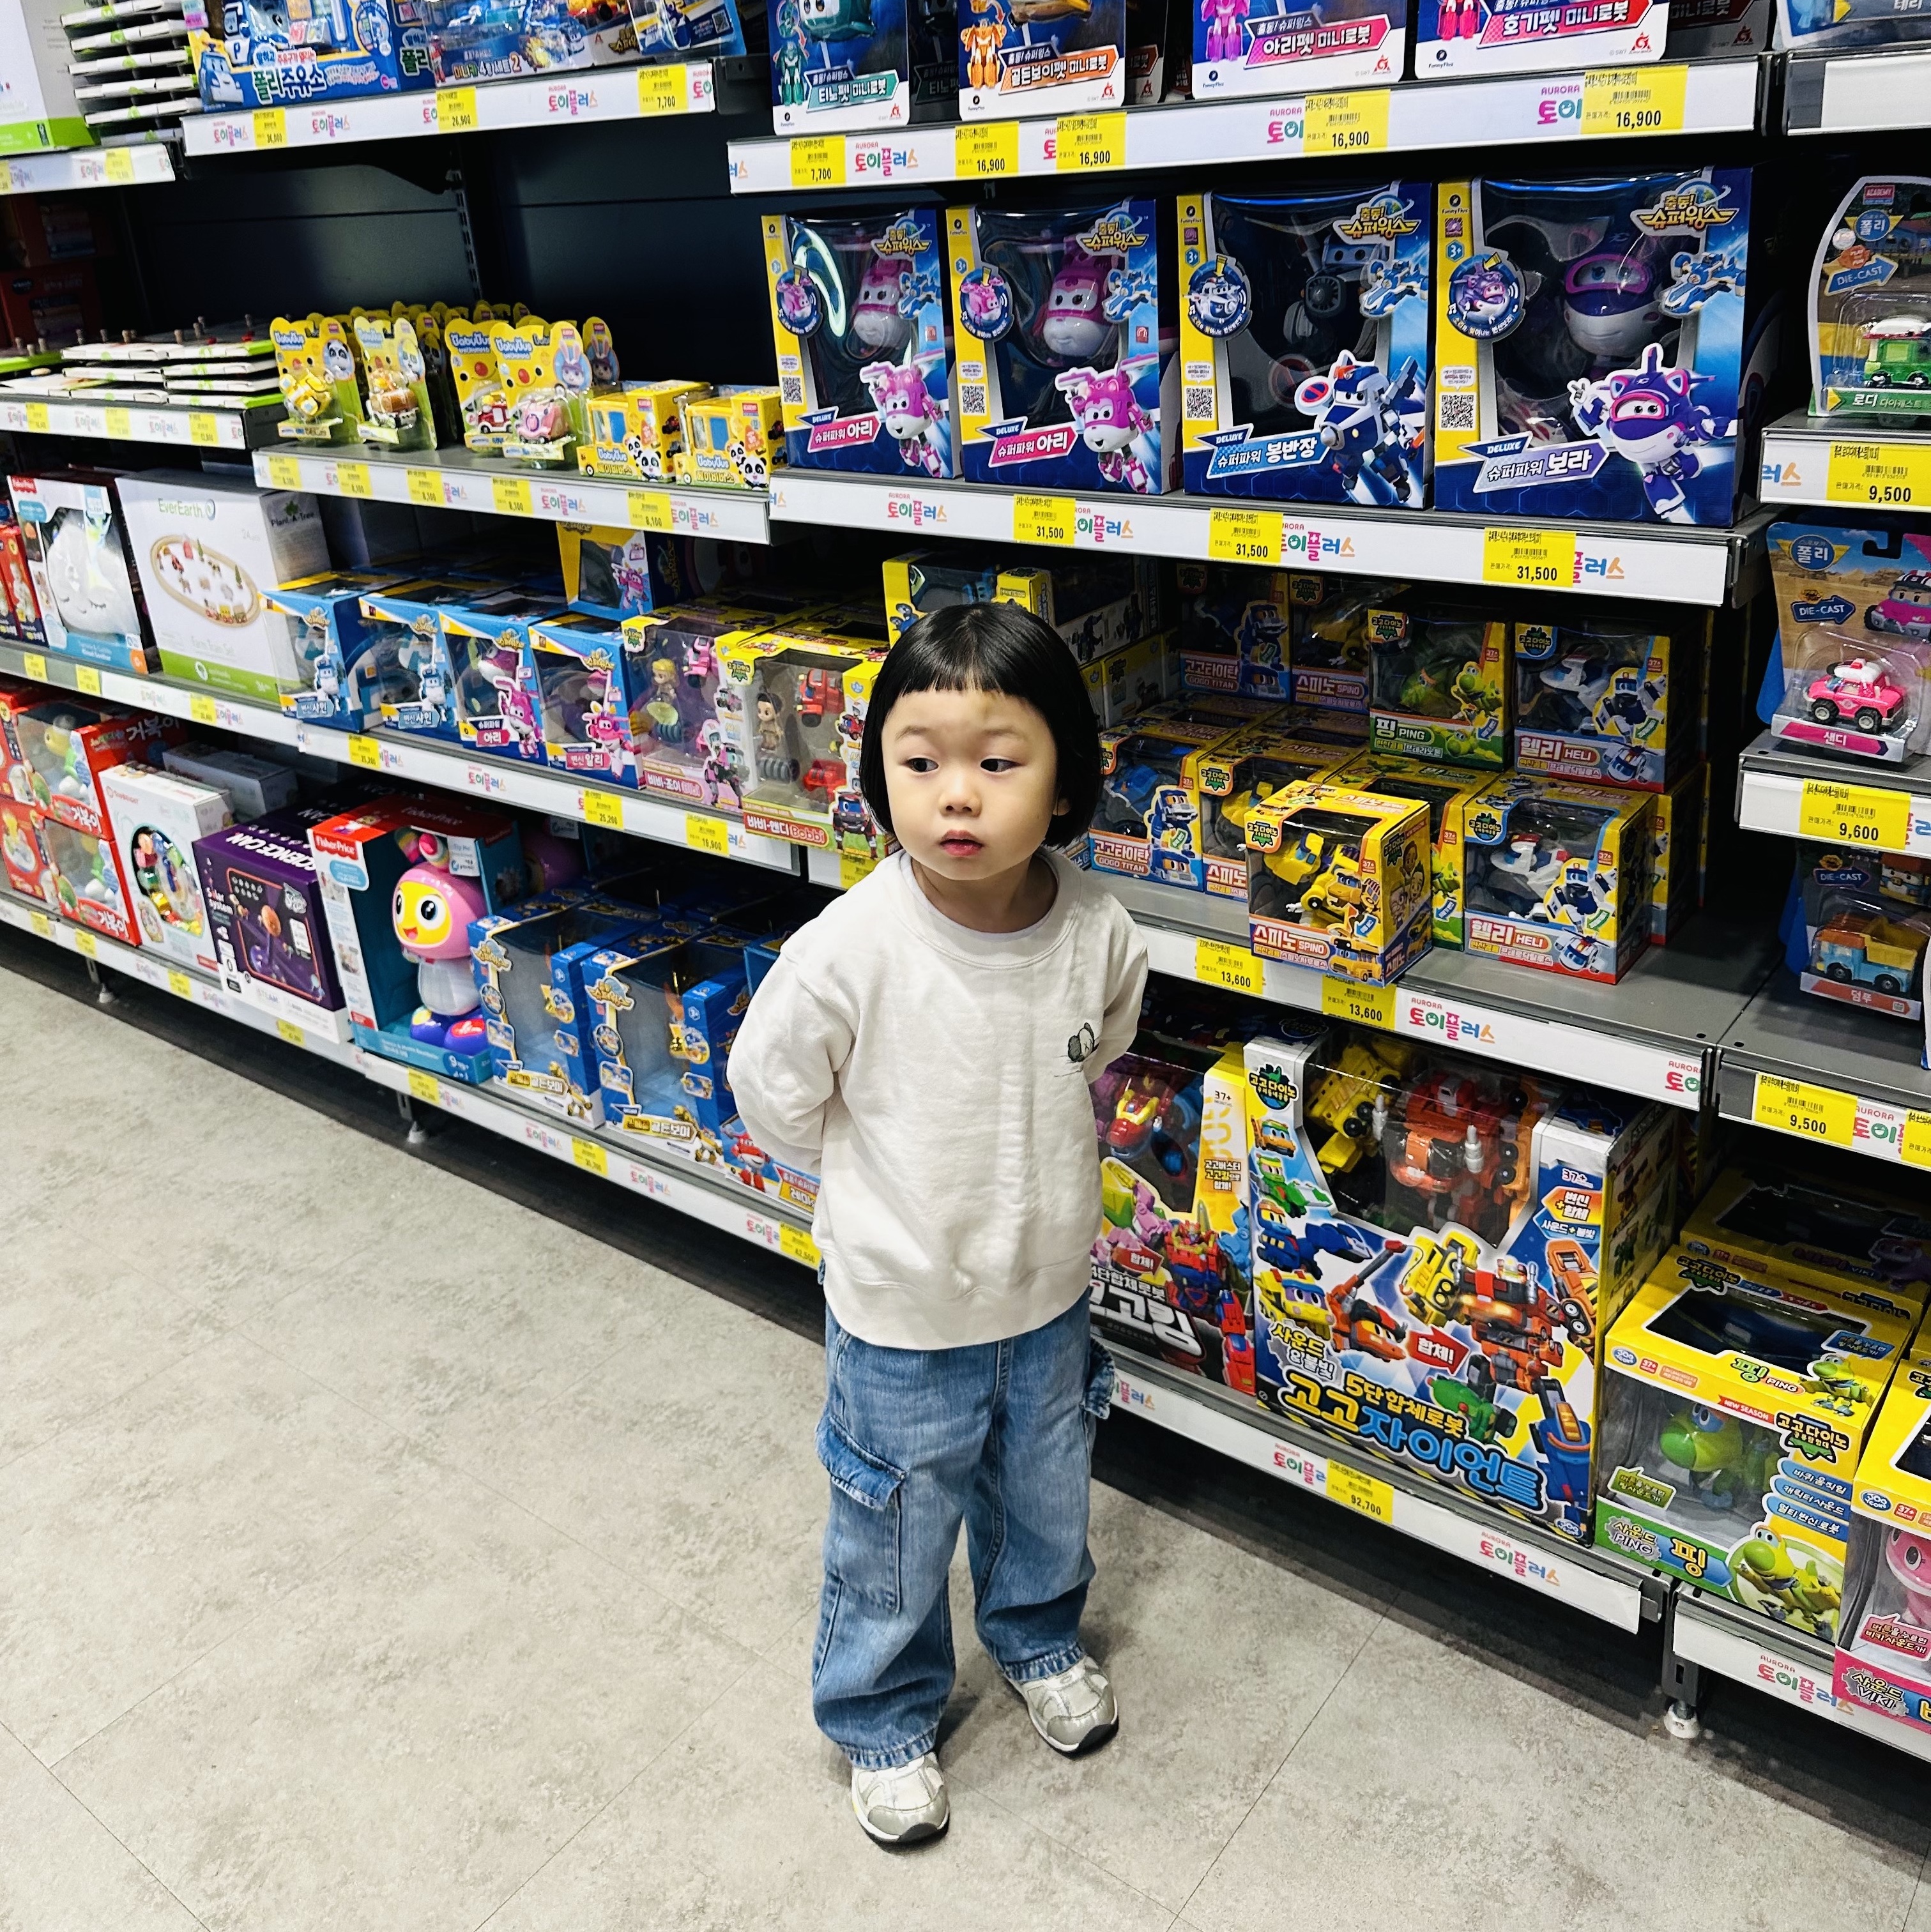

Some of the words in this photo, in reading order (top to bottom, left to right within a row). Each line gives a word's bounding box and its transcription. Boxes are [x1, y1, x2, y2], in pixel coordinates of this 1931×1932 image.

[1502, 13, 1563, 36] 호기펫
[1565, 1, 1630, 26] 미니로봇
[1263, 31, 1316, 58] 아리펫
[1317, 24, 1371, 49] 미니로봇
[510, 54, 521, 73] 2
[1541, 84, 1580, 95] AURORA
[1270, 107, 1302, 116] AURORA
[1615, 110, 1661, 128] 16,900
[1331, 131, 1370, 148] 16,900
[855, 149, 919, 176] 토이플러스
[976, 158, 1005, 172] 16,900
[1080, 150, 1110, 165] 16,900
[811, 168, 832, 181] 7,700
[1640, 206, 1736, 231] 슈퍼윙스
[1860, 219, 1886, 236] 폴리
[1450, 245, 1462, 257] 3+
[1836, 266, 1883, 286] DIE-CAST
[1852, 393, 1877, 407] 로디
[847, 416, 874, 438] 아리
[1037, 430, 1069, 452] 아리
[1216, 432, 1243, 444] DELUXE
[1487, 442, 1522, 454] DELUXE
[1217, 450, 1262, 468] 슈퍼파워
[1265, 436, 1318, 463] 봉반장
[1487, 460, 1544, 482] 슈퍼파워
[1545, 448, 1593, 476] 보라
[1869, 484, 1912, 503] 9,500
[158, 498, 203, 518] EverEarth
[888, 499, 948, 526] 토이플러스
[646, 516, 662, 526] 8,100
[1036, 526, 1064, 539] 31,500
[1235, 543, 1269, 558] 31,500
[1796, 545, 1829, 563] 폴리
[1516, 565, 1557, 581] 31,500
[1799, 604, 1845, 616] DIE-CAST
[1376, 717, 1397, 740] 핑
[1398, 729, 1425, 740] PING
[1824, 729, 1847, 747] 샌디
[1564, 749, 1591, 761] HELI
[1839, 822, 1879, 841] 9,600
[1820, 872, 1862, 882] DIE-CAST
[1471, 920, 1513, 944] 헬리
[1516, 935, 1543, 948] HELI
[1299, 941, 1324, 954] SPINO
[1221, 970, 1251, 988] 13,600
[1348, 1003, 1382, 1022] 13,600
[1411, 997, 1442, 1010] AURORA
[1409, 1007, 1496, 1044] 토이플러스
[1214, 1090, 1232, 1101] 37+
[1249, 1072, 1296, 1099] 고고다이노
[1790, 1114, 1827, 1134] 9,500
[1272, 1323, 1326, 1360] 사운드
[1417, 1335, 1454, 1365] 합체!
[1731, 1358, 1769, 1383] 핑
[1766, 1377, 1797, 1392] PING
[1723, 1400, 1738, 1409] NEW
[1739, 1404, 1769, 1420] SEASON
[1283, 1374, 1541, 1508] 고고자이언트
[1776, 1413, 1849, 1450] 고고다이노
[1794, 1468, 1813, 1482] 바퀴
[1814, 1475, 1847, 1495] 움직임
[1350, 1493, 1381, 1516] 92,700
[1783, 1485, 1813, 1502] 캐릭터
[1813, 1496, 1845, 1516] 사운드
[1897, 1504, 1914, 1514] 37+
[1778, 1502, 1797, 1517] 멀티
[1798, 1512, 1819, 1526] 변신
[1817, 1522, 1840, 1535] 로봇
[1613, 1521, 1655, 1545] 사운드
[1615, 1533, 1652, 1554] PING
[1479, 1538, 1561, 1586] 토이플러스
[1671, 1538, 1706, 1578] 핑
[1760, 1655, 1796, 1673] AURORA
[1757, 1664, 1855, 1715] 토이플러스
[1853, 1672, 1904, 1701] 사운드
[1858, 1686, 1895, 1708] VIKI
